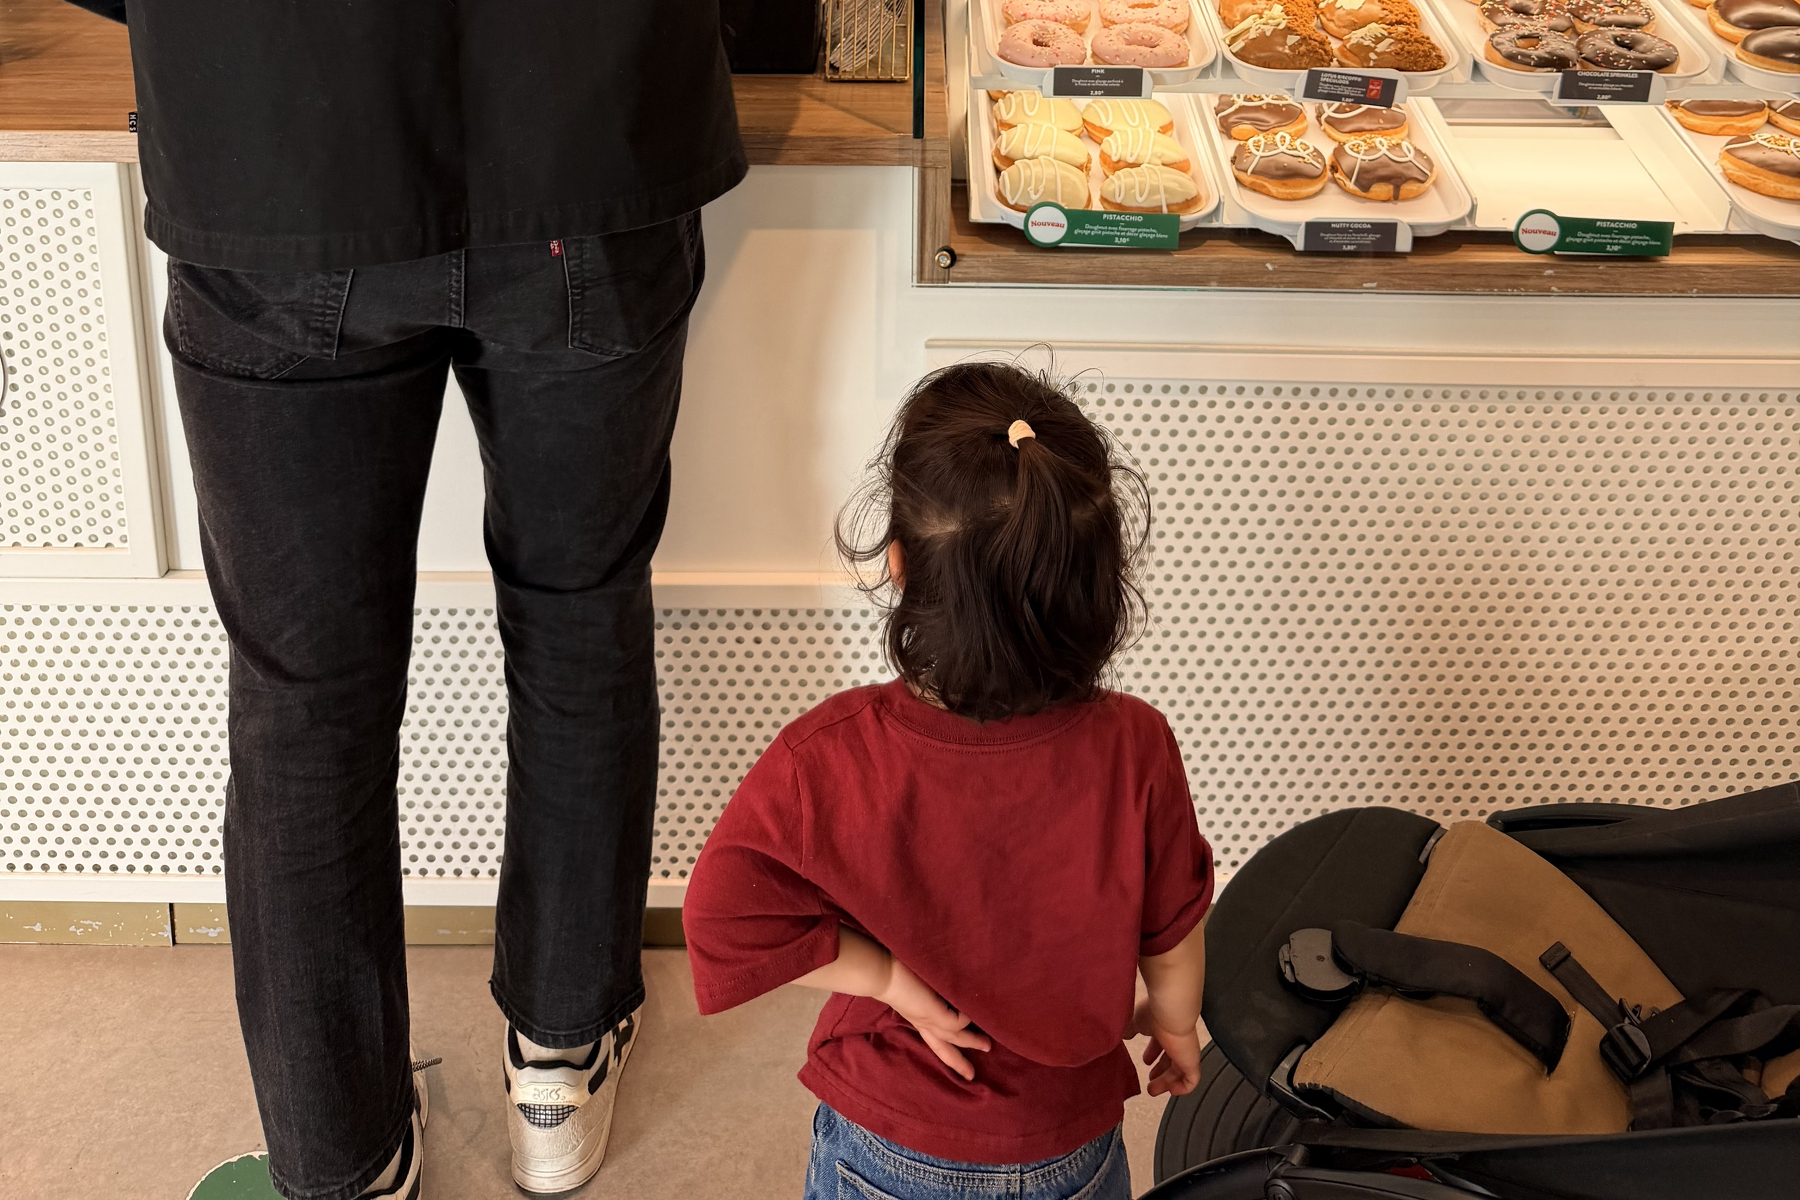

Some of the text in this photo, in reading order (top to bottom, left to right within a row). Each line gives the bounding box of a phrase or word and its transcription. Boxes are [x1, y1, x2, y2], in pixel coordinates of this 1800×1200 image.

[1102, 213, 1143, 222] PISTACCHIO
[1031, 220, 1065, 229] Nouveau
[1596, 221, 1638, 229] PISTACCHIO
[1521, 228, 1557, 237] Nouveau
[532, 1087, 561, 1101] asics
